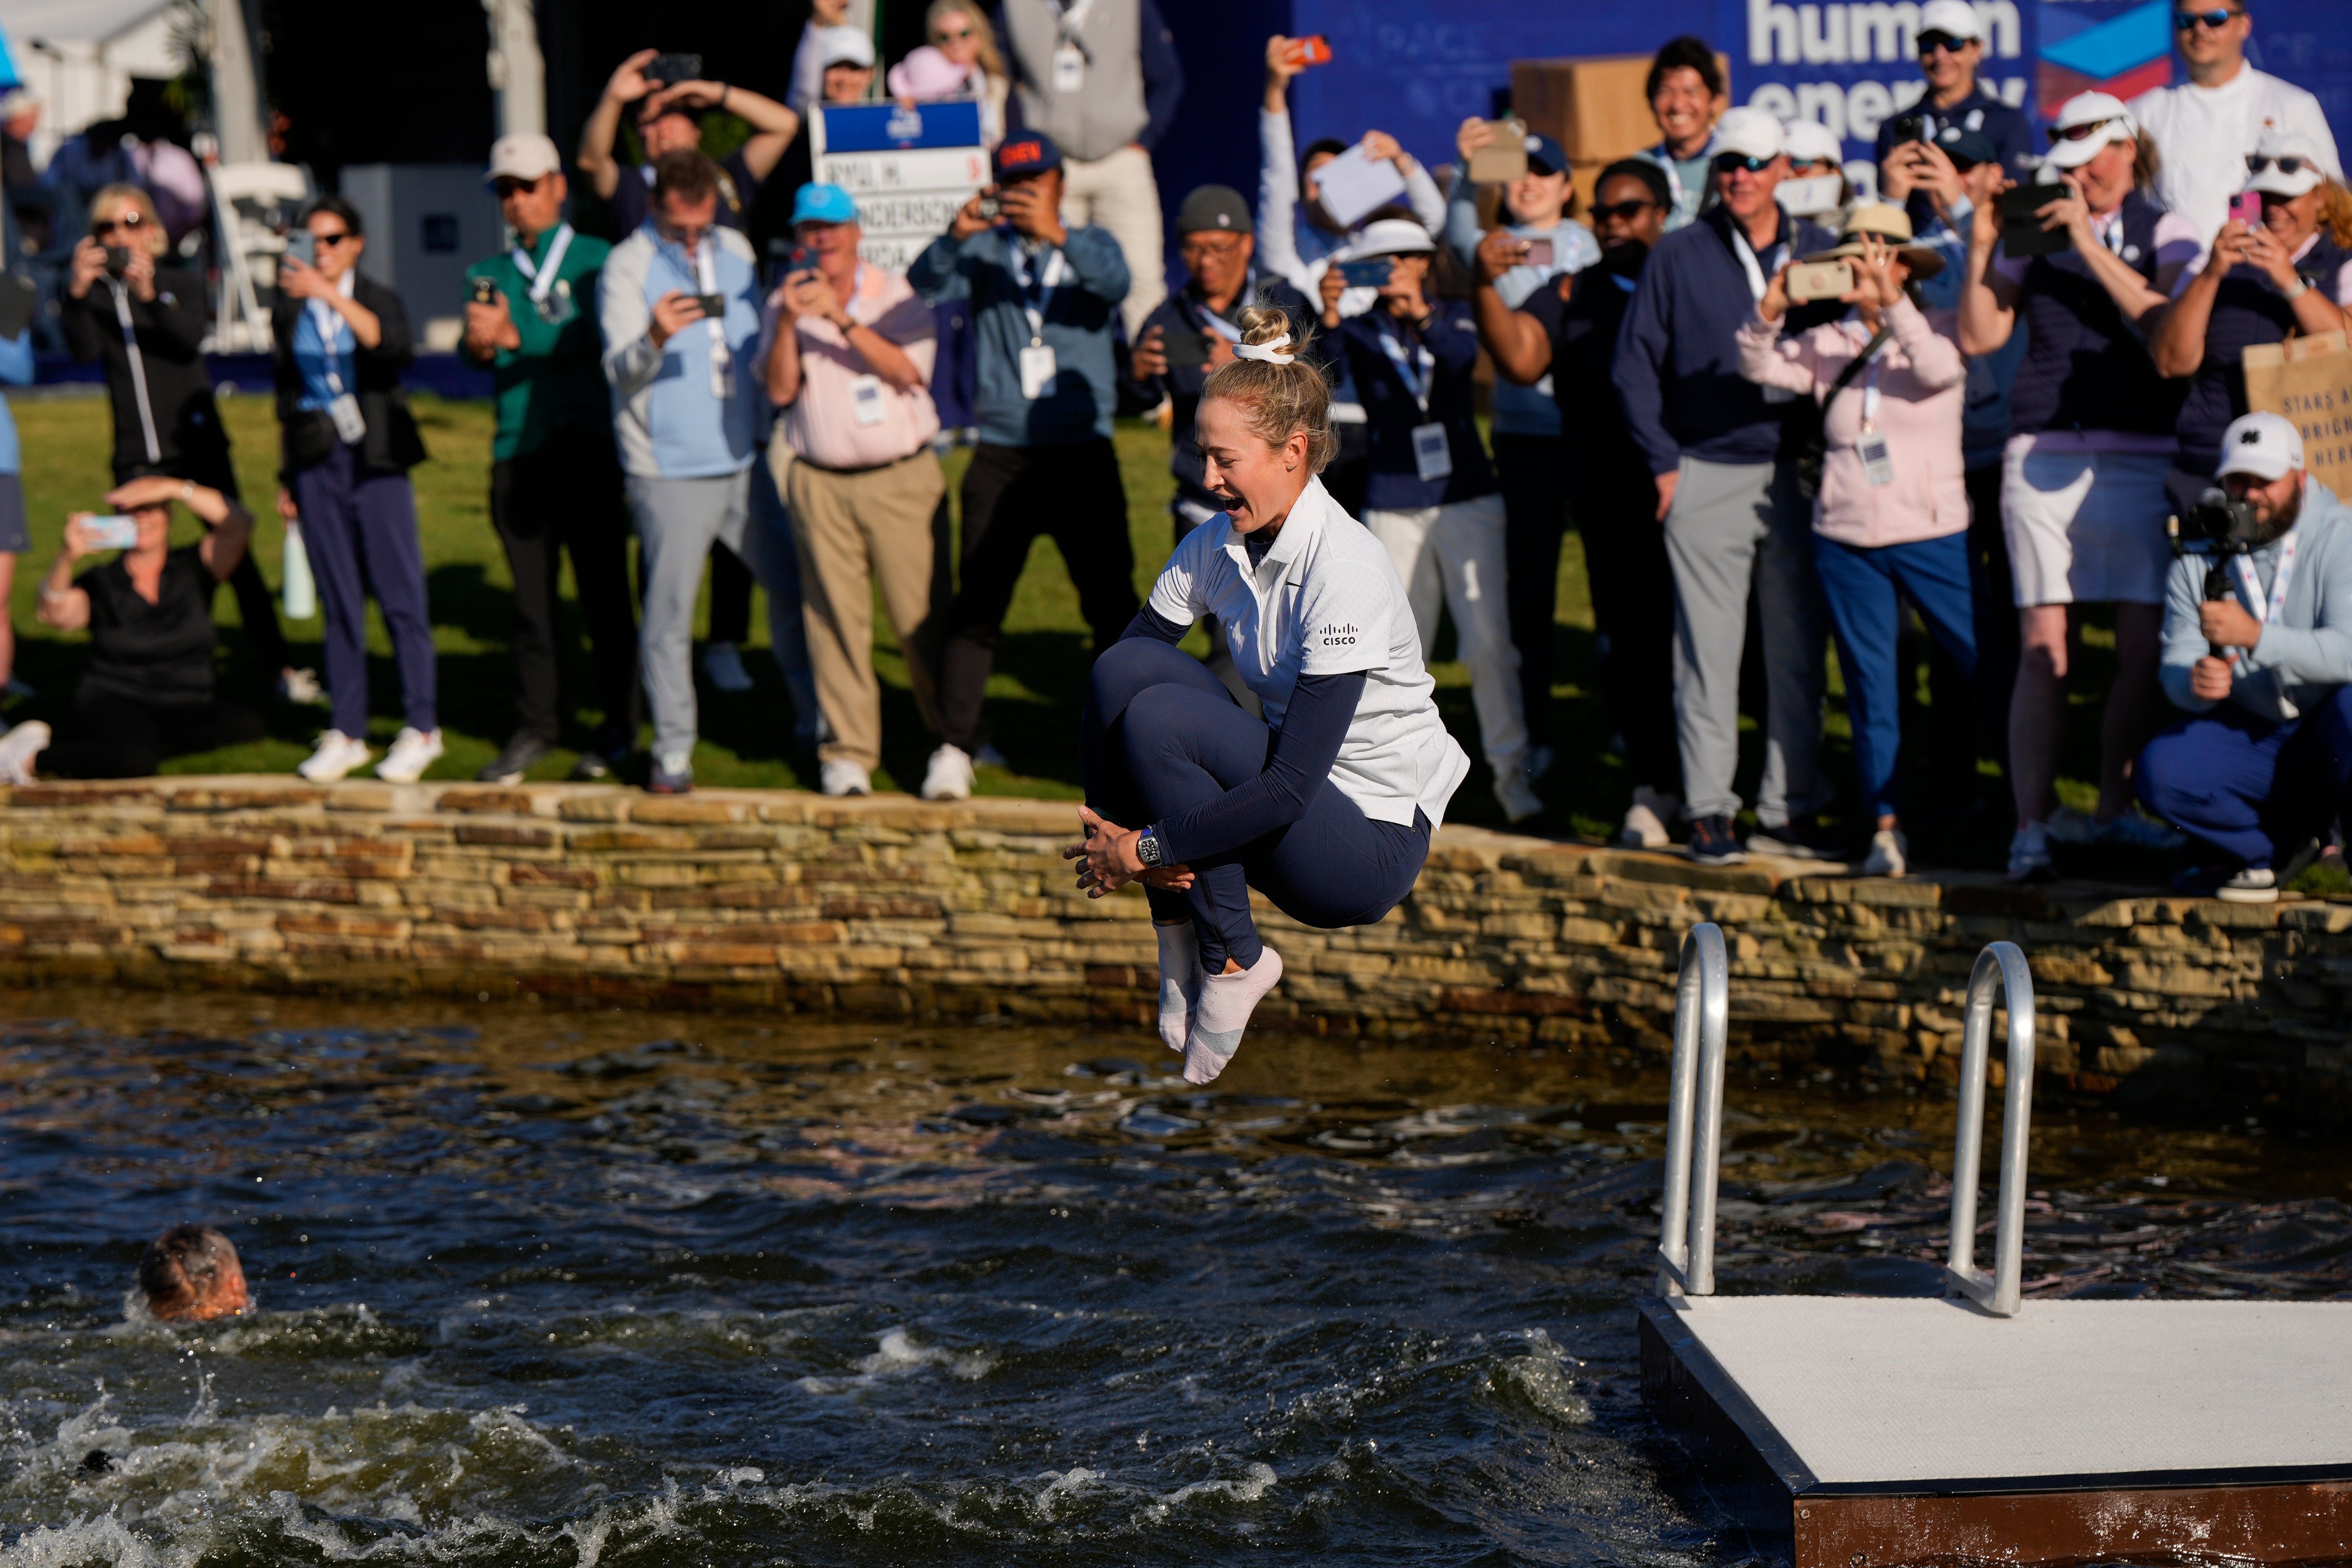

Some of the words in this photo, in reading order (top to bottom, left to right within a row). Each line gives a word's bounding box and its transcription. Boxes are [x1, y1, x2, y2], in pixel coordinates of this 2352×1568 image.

[1747, 0, 2022, 65] humn
[2283, 391, 2334, 416] STARS
[2341, 384, 2352, 405] A
